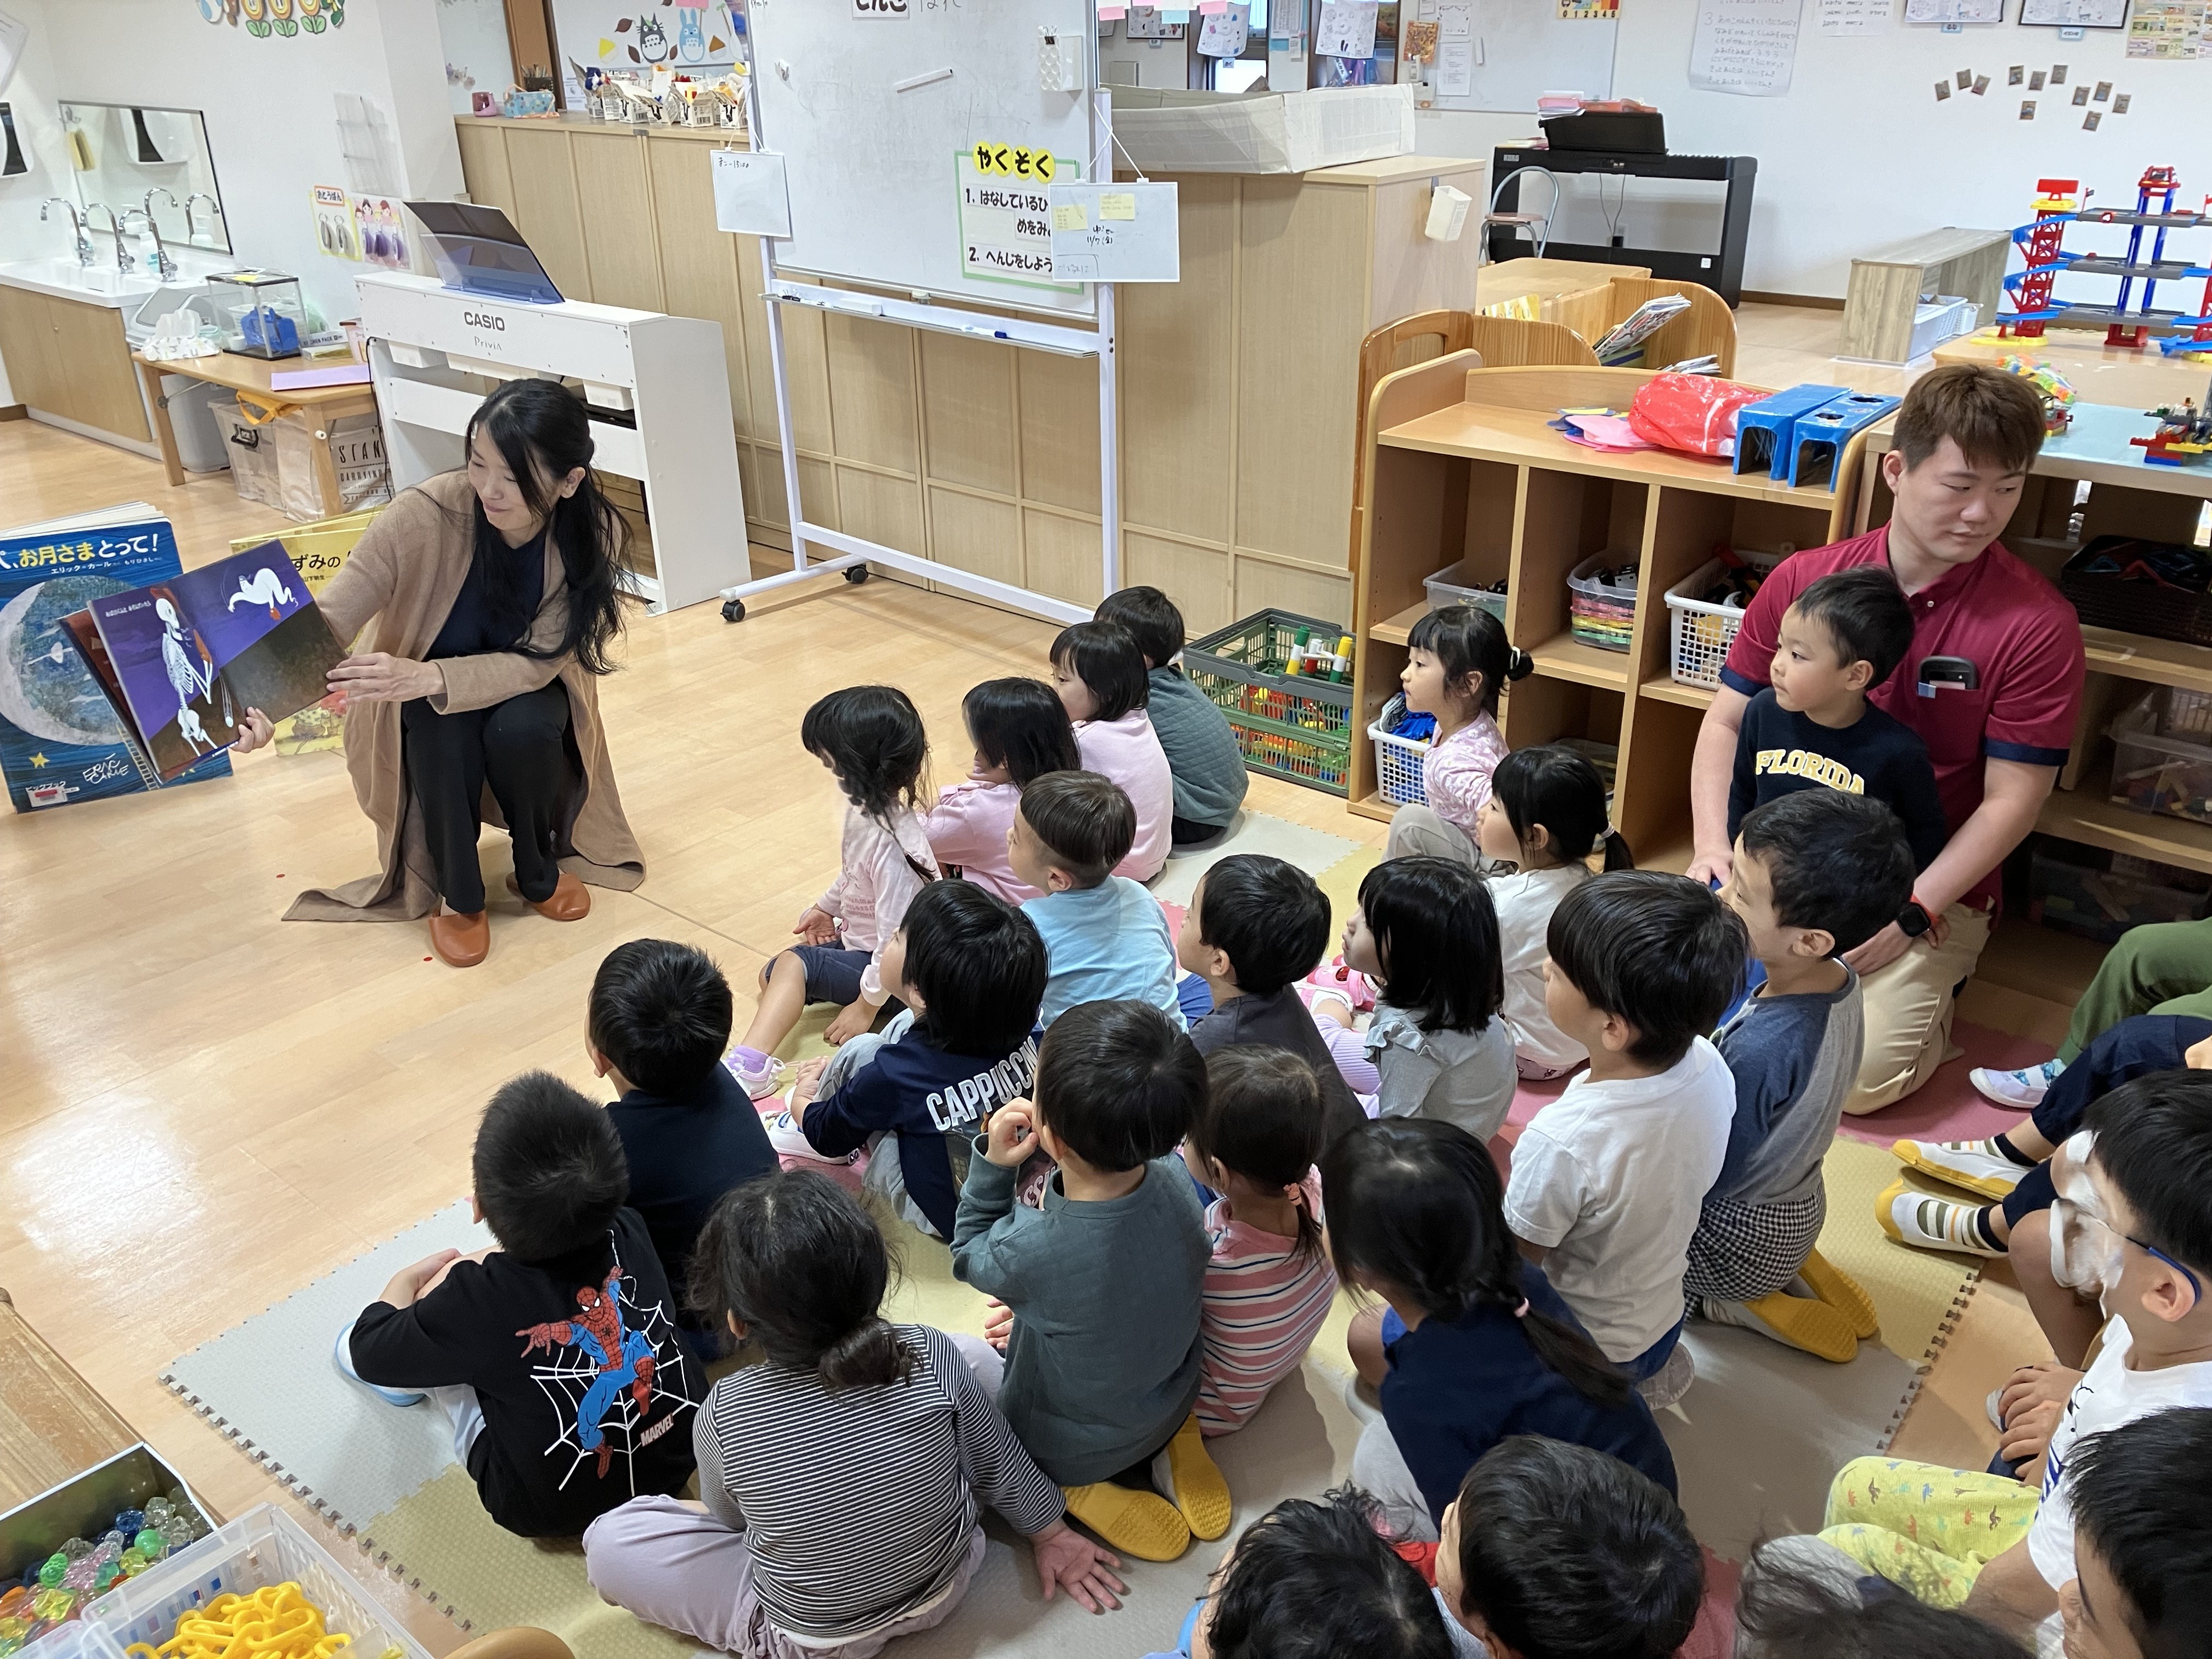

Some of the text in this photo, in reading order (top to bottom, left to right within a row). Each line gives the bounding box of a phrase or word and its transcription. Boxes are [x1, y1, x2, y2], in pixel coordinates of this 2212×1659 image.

[1704, 12, 1713, 25] 3
[977, 146, 1050, 178] やくそく
[966, 188, 1048, 212] 1. はなしているひ
[1017, 218, 1051, 237] めをみ
[2102, 213, 2112, 222] 4
[969, 247, 979, 262] 2.
[986, 250, 1052, 273] へんじをしよう
[464, 312, 505, 331] CASIO
[1756, 749, 1864, 795] FLORIDA
[641, 1413, 674, 1447] MARVEL
